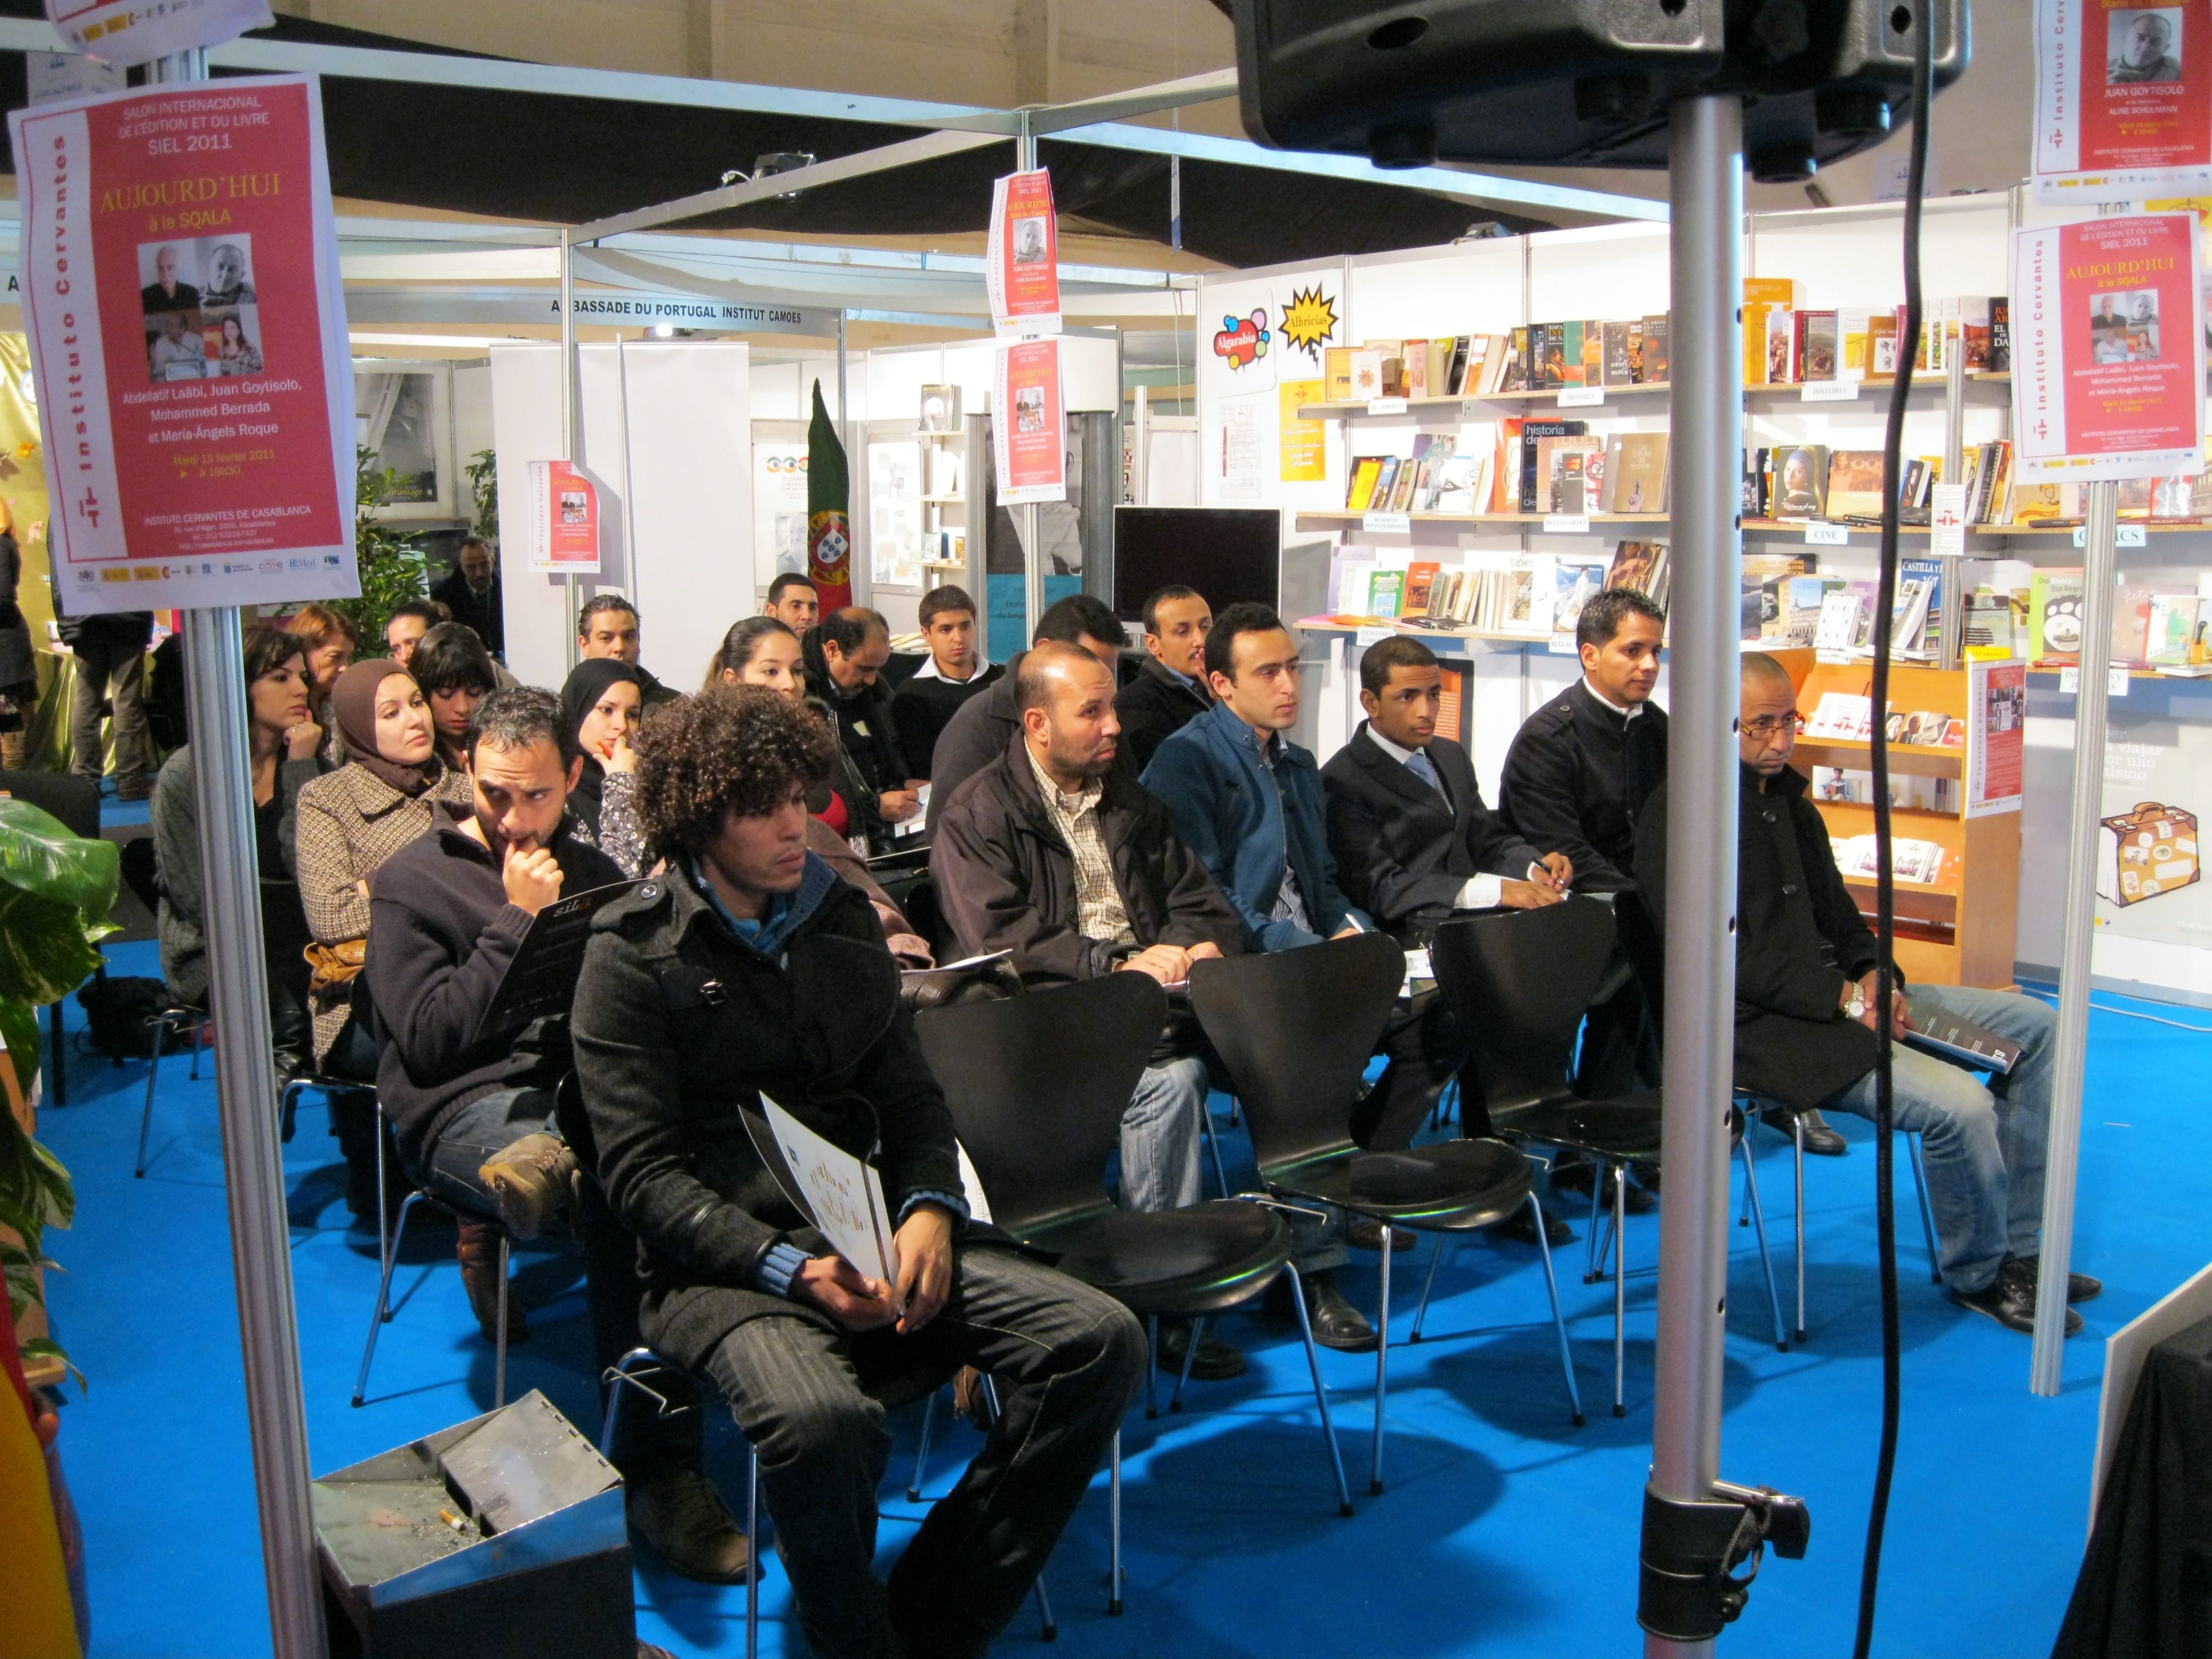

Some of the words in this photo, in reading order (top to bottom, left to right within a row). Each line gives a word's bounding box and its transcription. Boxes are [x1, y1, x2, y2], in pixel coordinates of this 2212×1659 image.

[2054, 43, 2064, 121] Instituto
[2104, 88, 2127, 98] JUAN
[2130, 85, 2184, 96] GOYTISOLO
[123, 105, 156, 121] SALON
[159, 96, 262, 114] INTERNACIONAL
[118, 126, 132, 139] DE
[191, 117, 208, 129] ET
[211, 114, 230, 128] DU
[233, 112, 270, 126] LIVRE
[148, 136, 182, 155] SIEL
[187, 134, 232, 152] 2011
[100, 173, 281, 214] AUJOURD'HUI
[54, 136, 70, 295] Cervantes
[149, 217, 158, 232] à
[161, 216, 175, 229] la
[179, 211, 232, 229] SQALA
[2100, 239, 2121, 250] SIEL
[2123, 238, 2149, 248] 2011
[2066, 257, 2176, 279] AUJOURD'HUI
[2033, 240, 2043, 321] Cervantes
[2106, 279, 2115, 287] la
[2116, 275, 2147, 286] SQALA
[551, 299, 632, 314] ABASSADE
[635, 302, 652, 316] DU
[656, 304, 717, 319] PORTUGAL
[722, 306, 765, 321] INSTITUT
[768, 310, 802, 324] CAMOES
[1288, 314, 1327, 328] Albricias
[1216, 331, 1256, 352] Algarabía
[2035, 330, 2047, 411] Instituto
[2091, 377, 2131, 385] Mohammed
[2133, 373, 2162, 382] Berrada
[63, 313, 92, 470] Instituto
[123, 388, 170, 404] Abdellatif
[211, 383, 239, 397] Juan
[242, 380, 302, 396] Goytisolo,
[1566, 393, 1595, 402] HISTORIA
[1812, 387, 1848, 396] HISTORIA
[150, 404, 218, 422] Mohammed
[221, 401, 270, 416] Berrada
[149, 432, 159, 444] et
[239, 422, 279, 439] Roque
[1526, 425, 1564, 436] historia
[249, 448, 275, 461] 2011
[144, 514, 182, 526] INSTITUTO
[183, 510, 235, 524] CERVANTES
[237, 510, 249, 520] DE
[252, 504, 312, 519] CASABLANCA
[1814, 530, 1838, 540] CINE
[1902, 561, 1934, 573] CASTILLA
[2051, 576, 2072, 585] Blanco
[2119, 742, 2164, 757] viajar
[2106, 755, 2122, 765] or
[2127, 757, 2156, 768] uno
